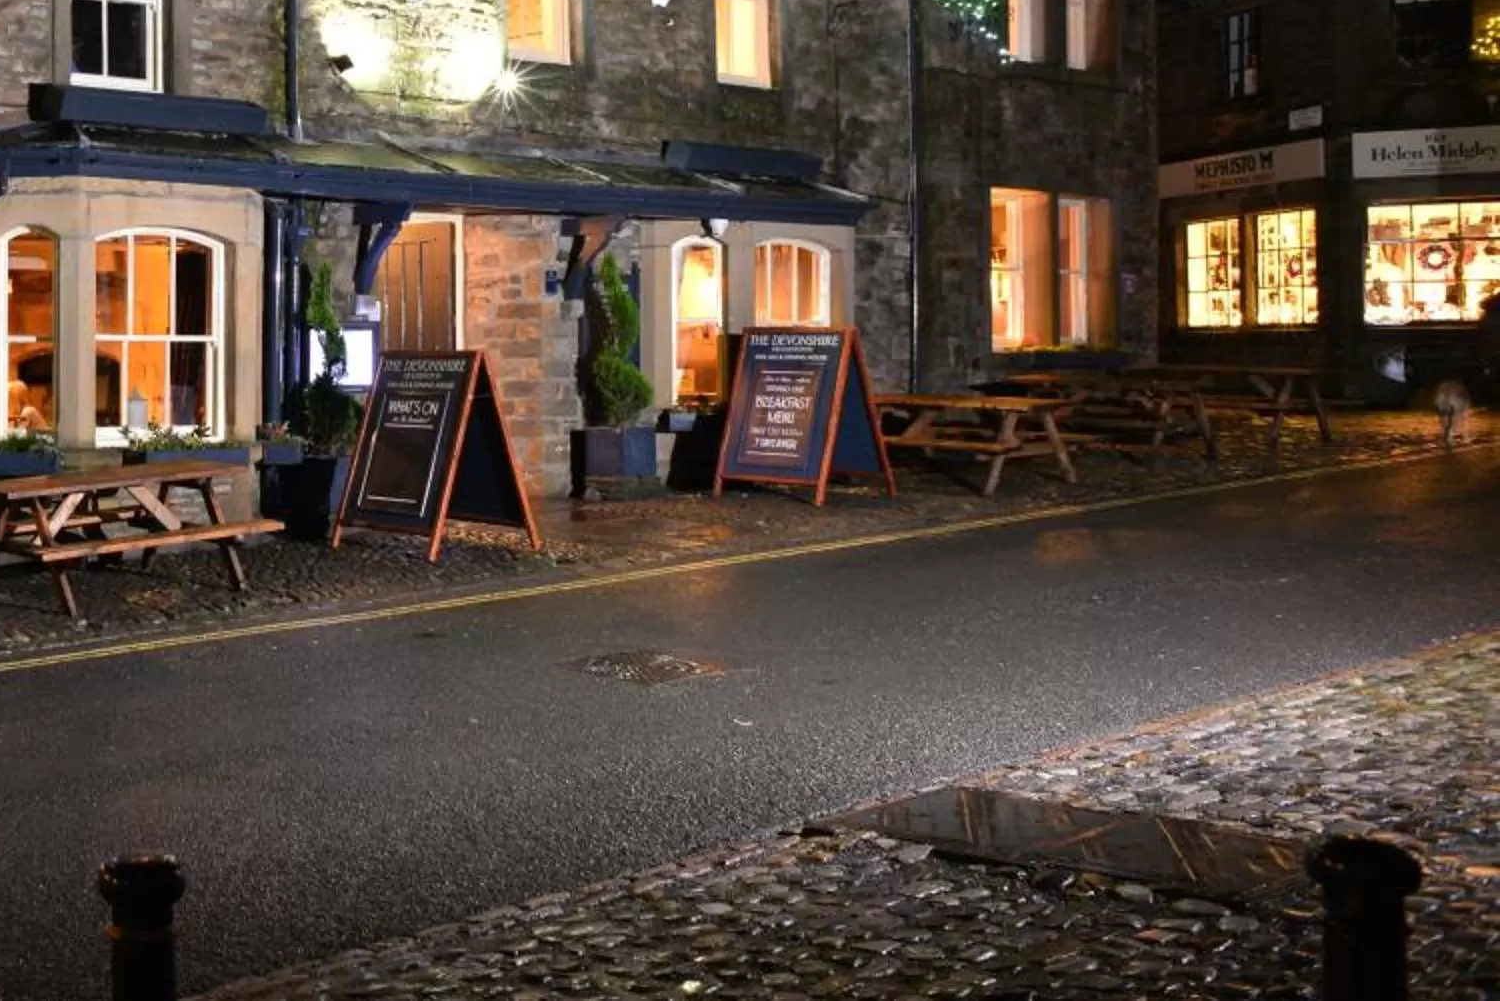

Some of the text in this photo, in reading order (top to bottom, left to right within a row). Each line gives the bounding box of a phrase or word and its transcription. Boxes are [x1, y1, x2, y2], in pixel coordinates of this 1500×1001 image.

[1370, 145, 1424, 163] Helen
[1427, 139, 1498, 161] Midgley
[1194, 155, 1257, 178] MEPHISTO
[750, 334, 840, 346] THE DEVONSHIRE
[422, 400, 440, 416] ON
[755, 395, 813, 410] BREAKFAST
